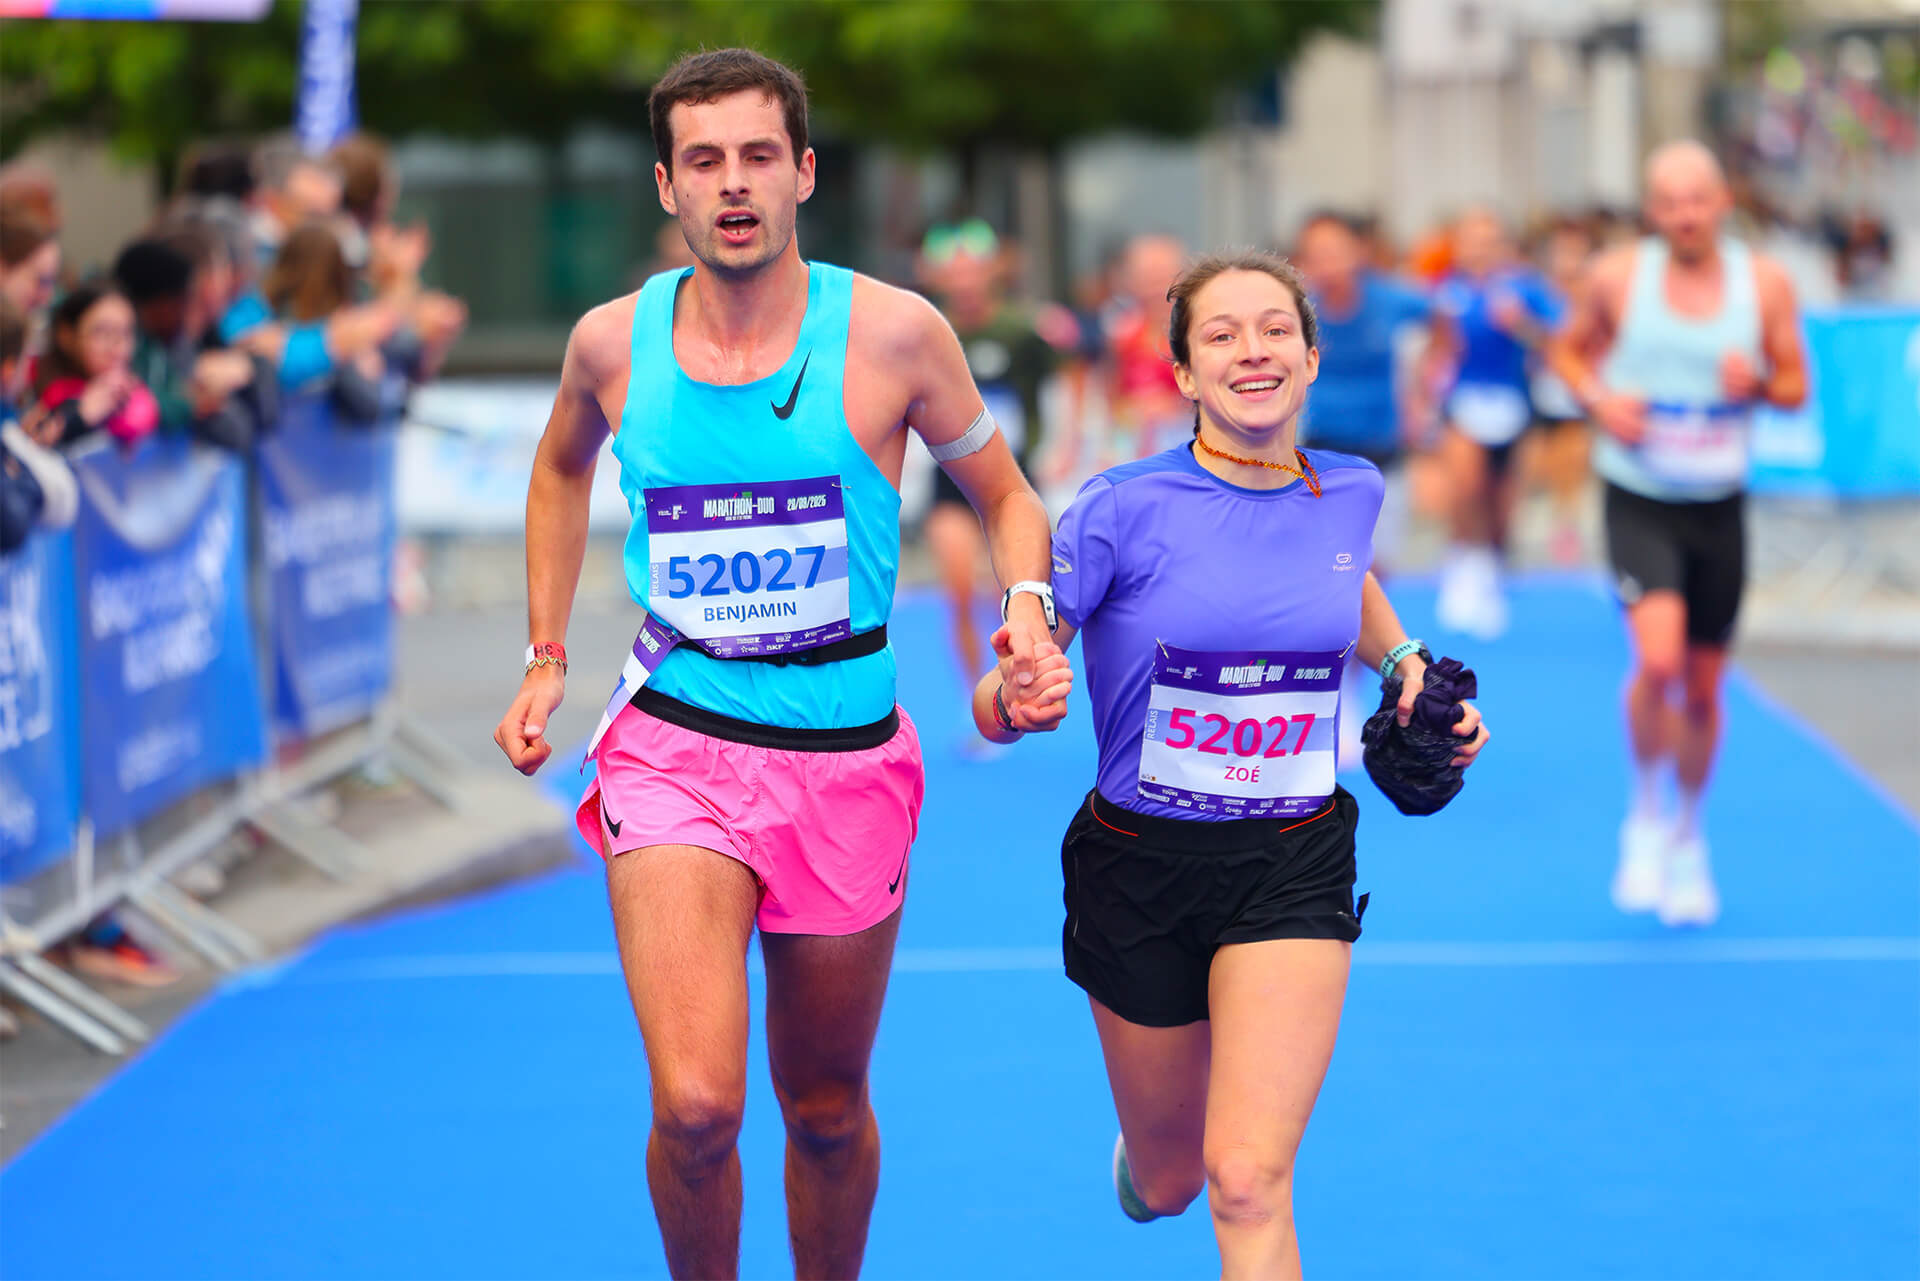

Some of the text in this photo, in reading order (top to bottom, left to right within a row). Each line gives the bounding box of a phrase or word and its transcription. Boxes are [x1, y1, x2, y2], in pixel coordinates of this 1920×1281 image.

[703, 496, 775, 518] MARATHON-DUO
[668, 545, 826, 599] 52027
[704, 601, 797, 623] BENJAMIN
[1147, 710, 1158, 739] RELAIS
[1165, 708, 1316, 759] 52027
[1224, 766, 1261, 783] ZOÉ
